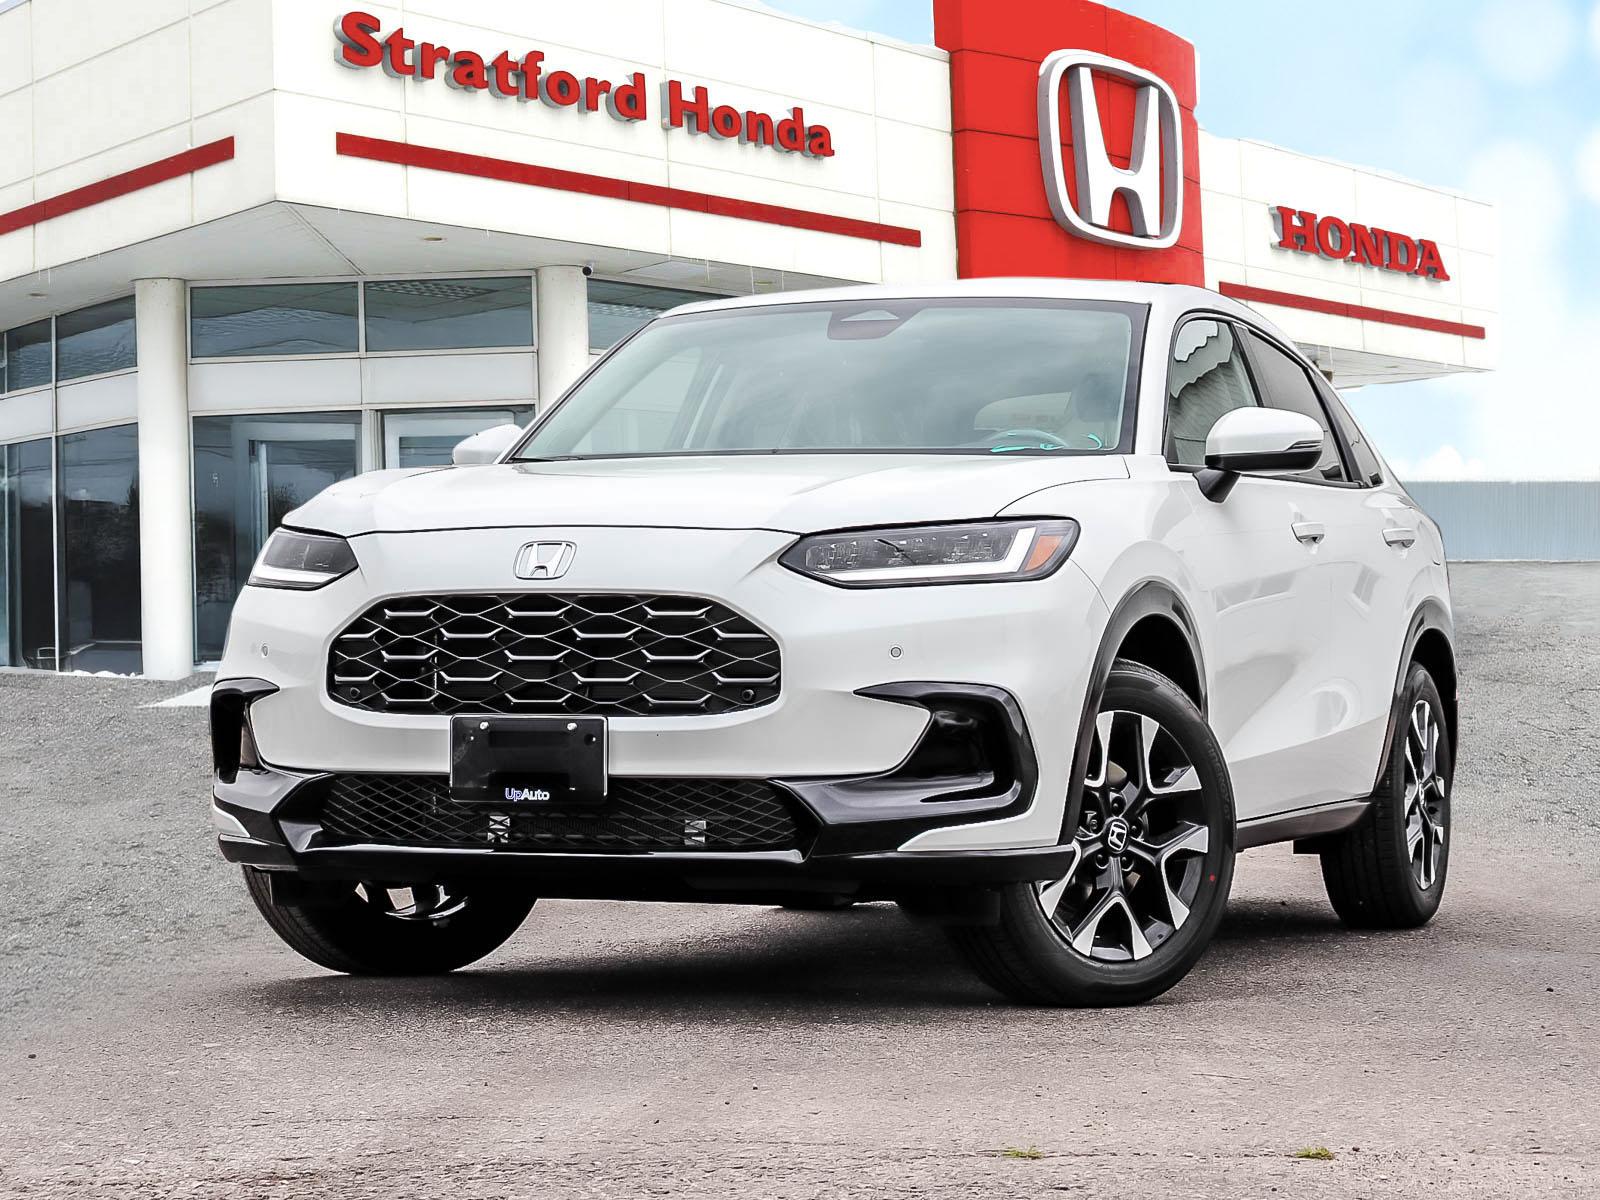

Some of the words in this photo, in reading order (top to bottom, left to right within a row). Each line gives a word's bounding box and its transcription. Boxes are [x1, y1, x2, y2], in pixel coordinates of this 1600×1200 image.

[336, 11, 647, 121] Stratford
[663, 80, 834, 158] Honda
[1271, 206, 1450, 281] HONDA
